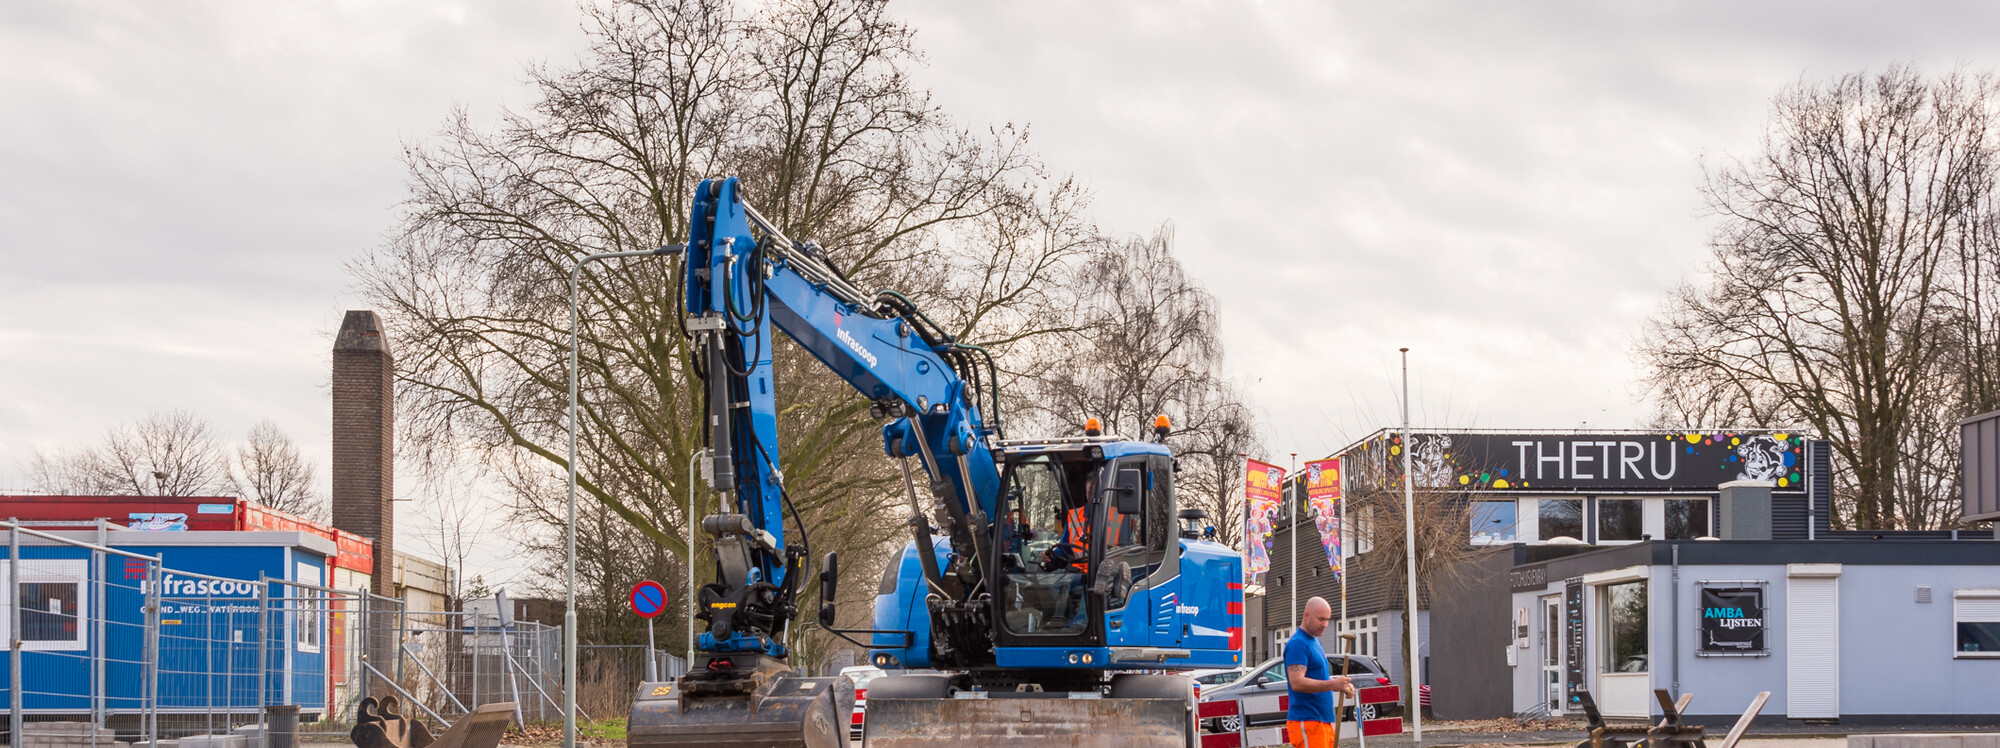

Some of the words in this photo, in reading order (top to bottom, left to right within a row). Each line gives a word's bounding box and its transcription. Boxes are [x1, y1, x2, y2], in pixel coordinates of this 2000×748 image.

[837, 327, 878, 368] infrascoop
[1511, 441, 1677, 481] THETRU
[711, 602, 737, 610] engcon
[1704, 607, 1744, 618] AMBA
[1720, 618, 1762, 629] LIJSTEN
